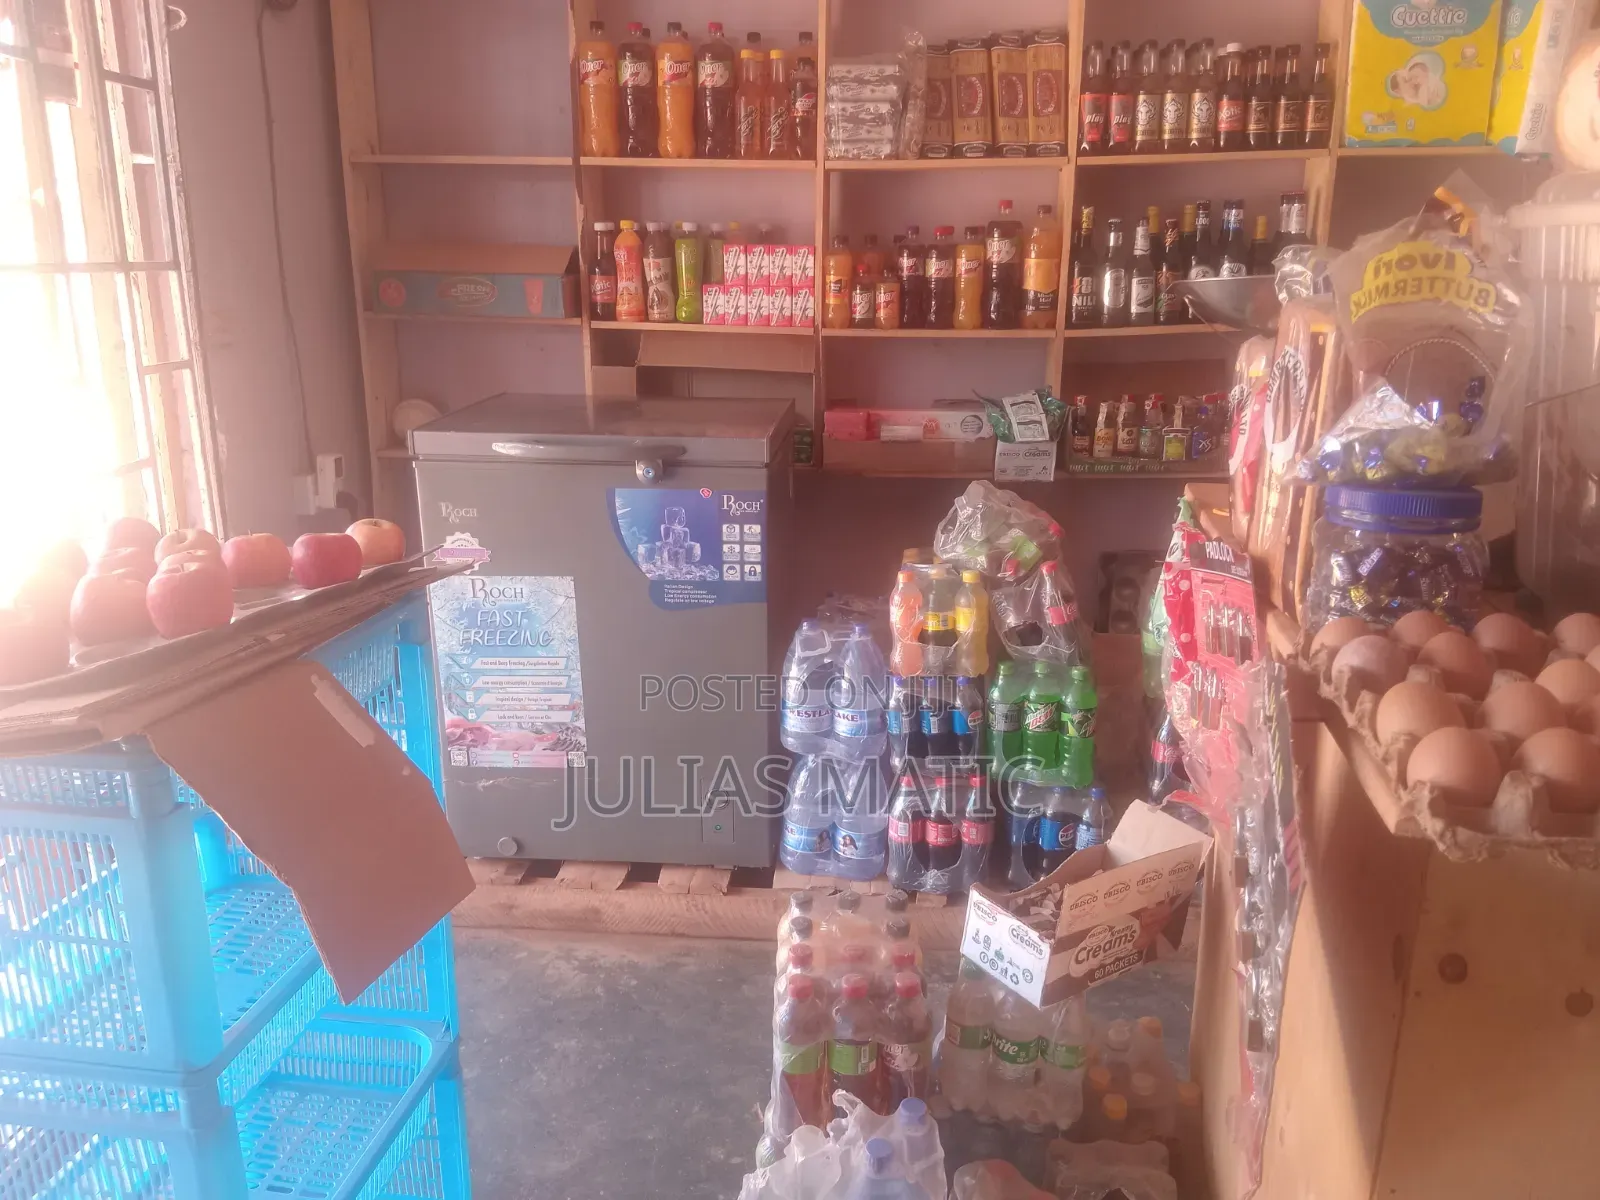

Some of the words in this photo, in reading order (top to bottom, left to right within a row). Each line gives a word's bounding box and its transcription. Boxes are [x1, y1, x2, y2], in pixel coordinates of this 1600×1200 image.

[1391, 5, 1468, 28] Cuettie
[665, 60, 690, 75] Oner
[1205, 541, 1235, 564] PADLOCK
[477, 609, 528, 628] FAST
[460, 628, 554, 647] FREEZING
[1136, 872, 1164, 887] UBISCO
[1103, 884, 1131, 900] UBISCO
[1069, 895, 1099, 911] UBISCO
[1011, 928, 1044, 956] Creams
[1074, 930, 1137, 965] Creams
[1094, 968, 1104, 979] 60
[1105, 953, 1140, 975] PACKETS
